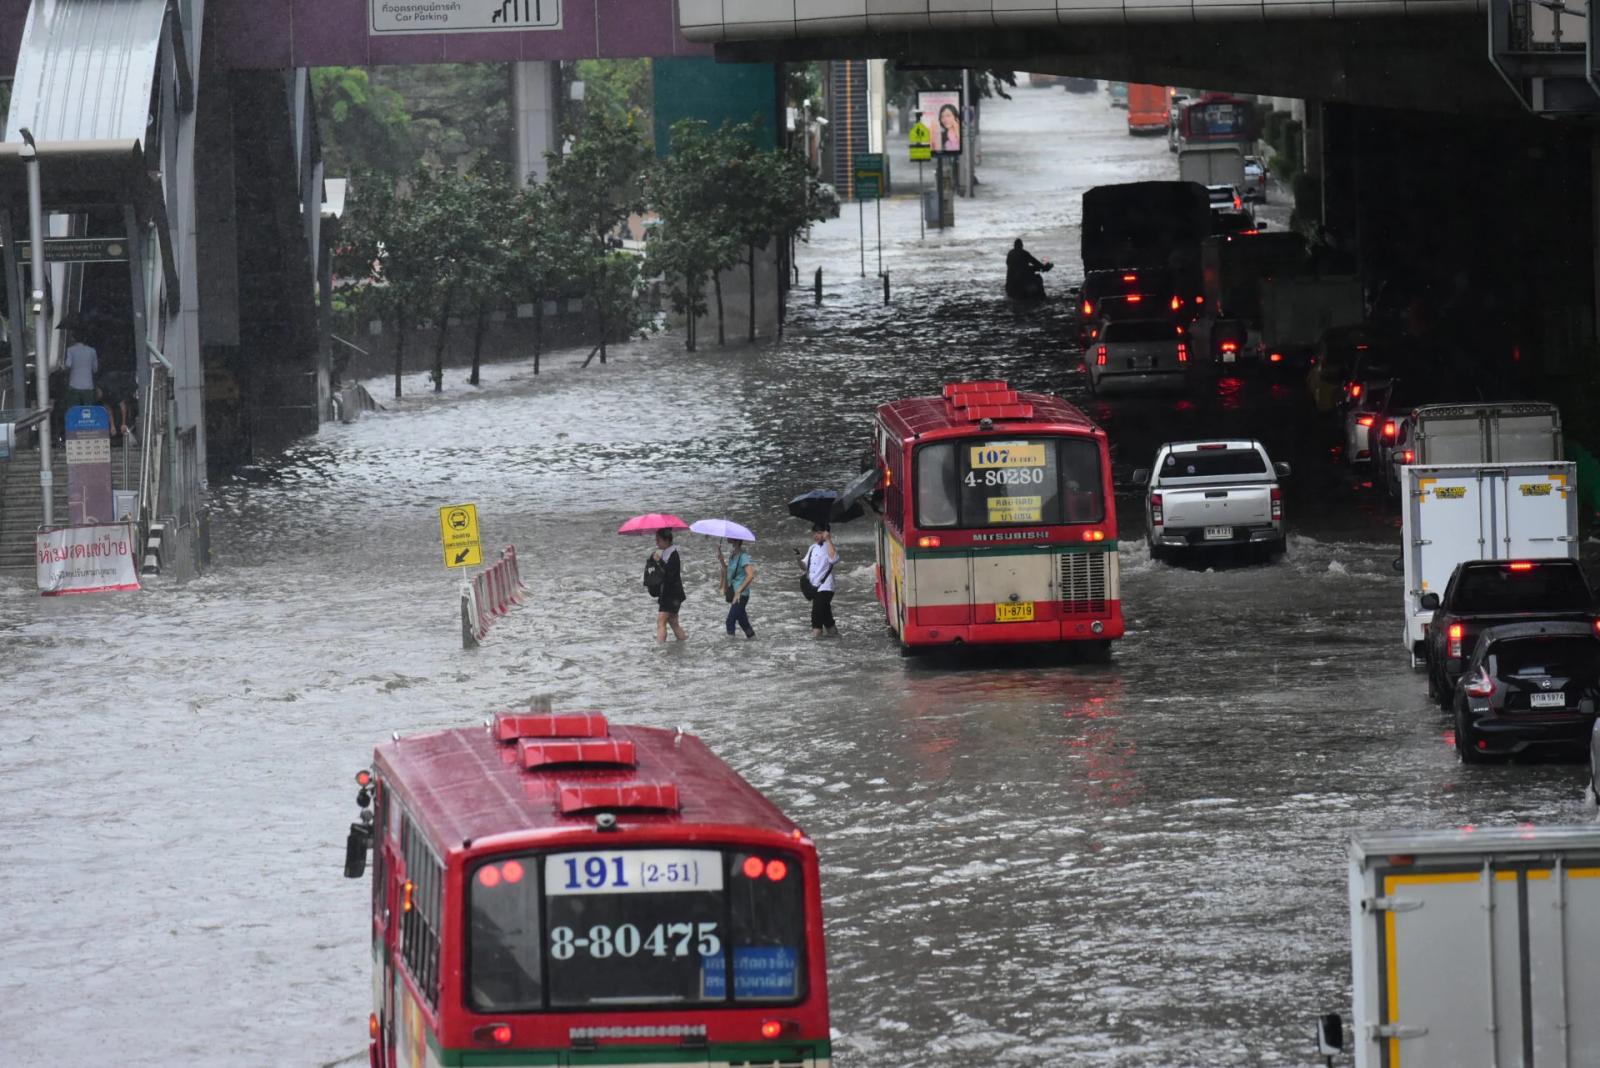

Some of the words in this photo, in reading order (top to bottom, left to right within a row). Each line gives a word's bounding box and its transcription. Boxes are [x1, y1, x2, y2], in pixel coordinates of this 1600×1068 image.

[395, 13, 412, 22] Car
[414, 12, 448, 22] Parking
[978, 449, 1010, 465] 107
[964, 468, 1044, 487] 4-80280
[972, 531, 1050, 541] MITSUBISHI
[564, 856, 629, 889] 191
[640, 860, 700, 887] (2-51)
[551, 922, 721, 960] 8-80475
